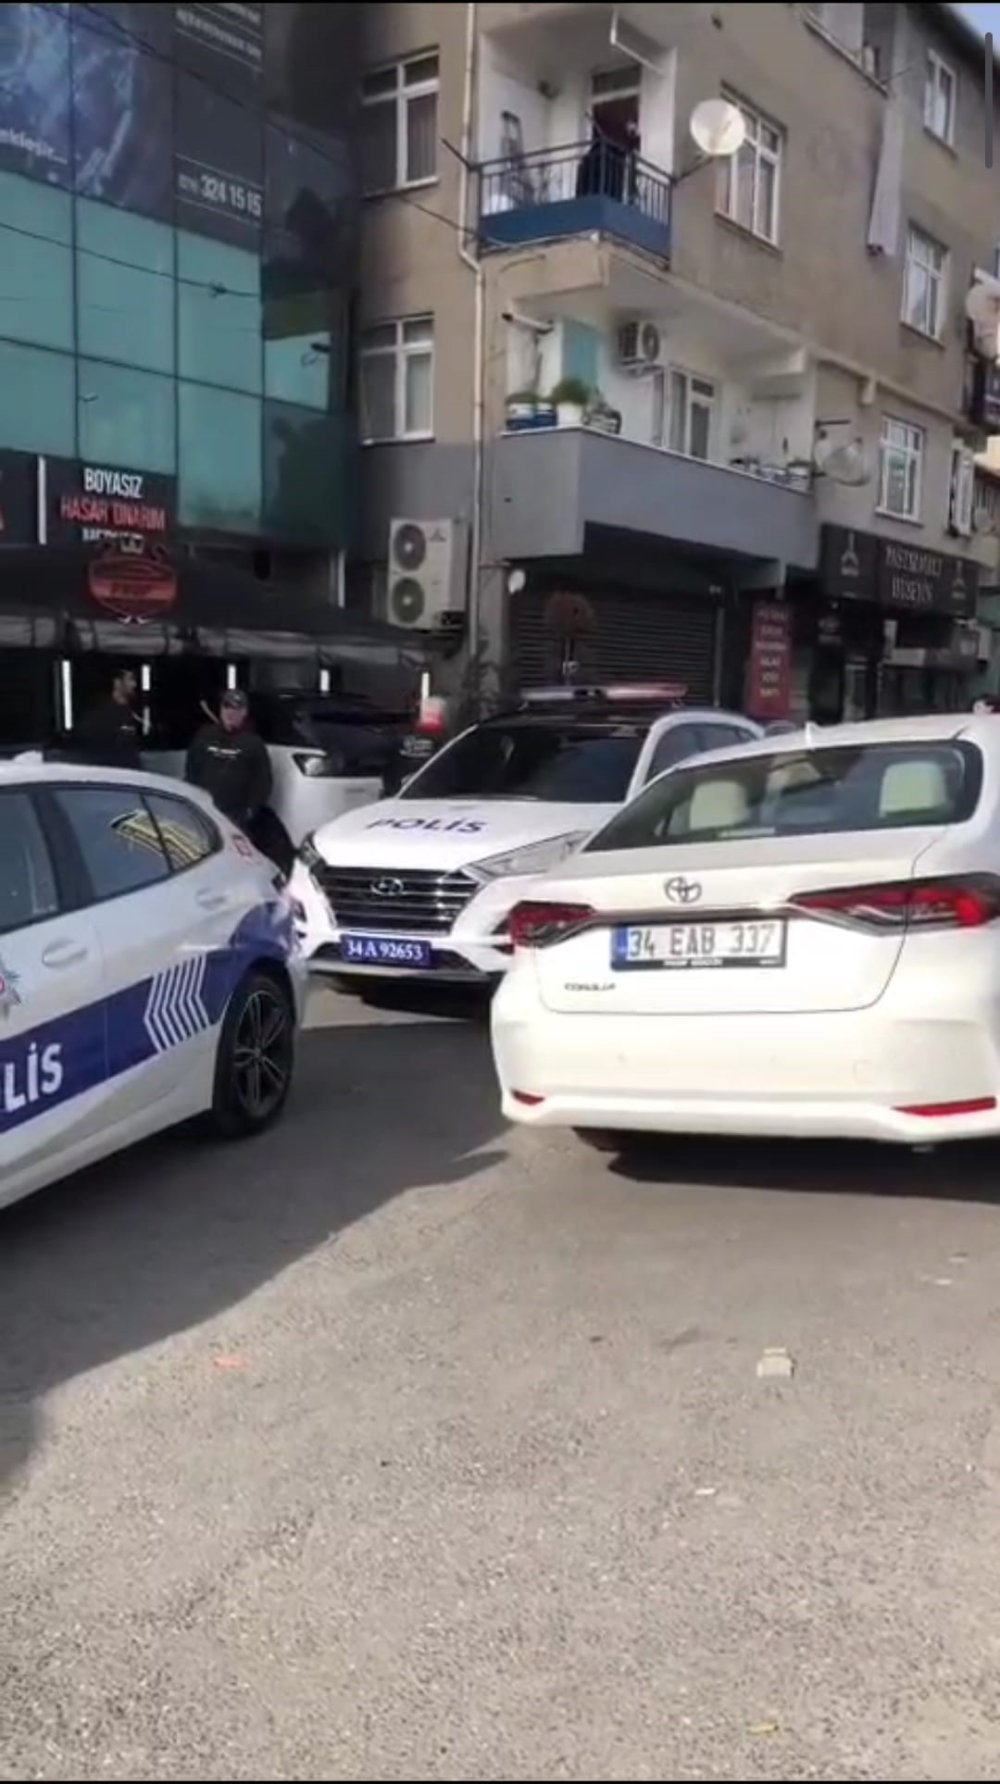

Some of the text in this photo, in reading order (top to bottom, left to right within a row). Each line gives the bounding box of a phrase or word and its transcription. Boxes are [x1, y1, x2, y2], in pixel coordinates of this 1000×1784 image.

[201, 174, 227, 203] 324
[229, 185, 246, 210] 15
[247, 190, 262, 217] 15
[84, 467, 143, 499] BOYASIZ
[364, 817, 488, 833] POLİS
[347, 940, 423, 960] 34 A 92653
[629, 923, 776, 957] 34 EAB 337
[5, 1042, 63, 1111] LİS
